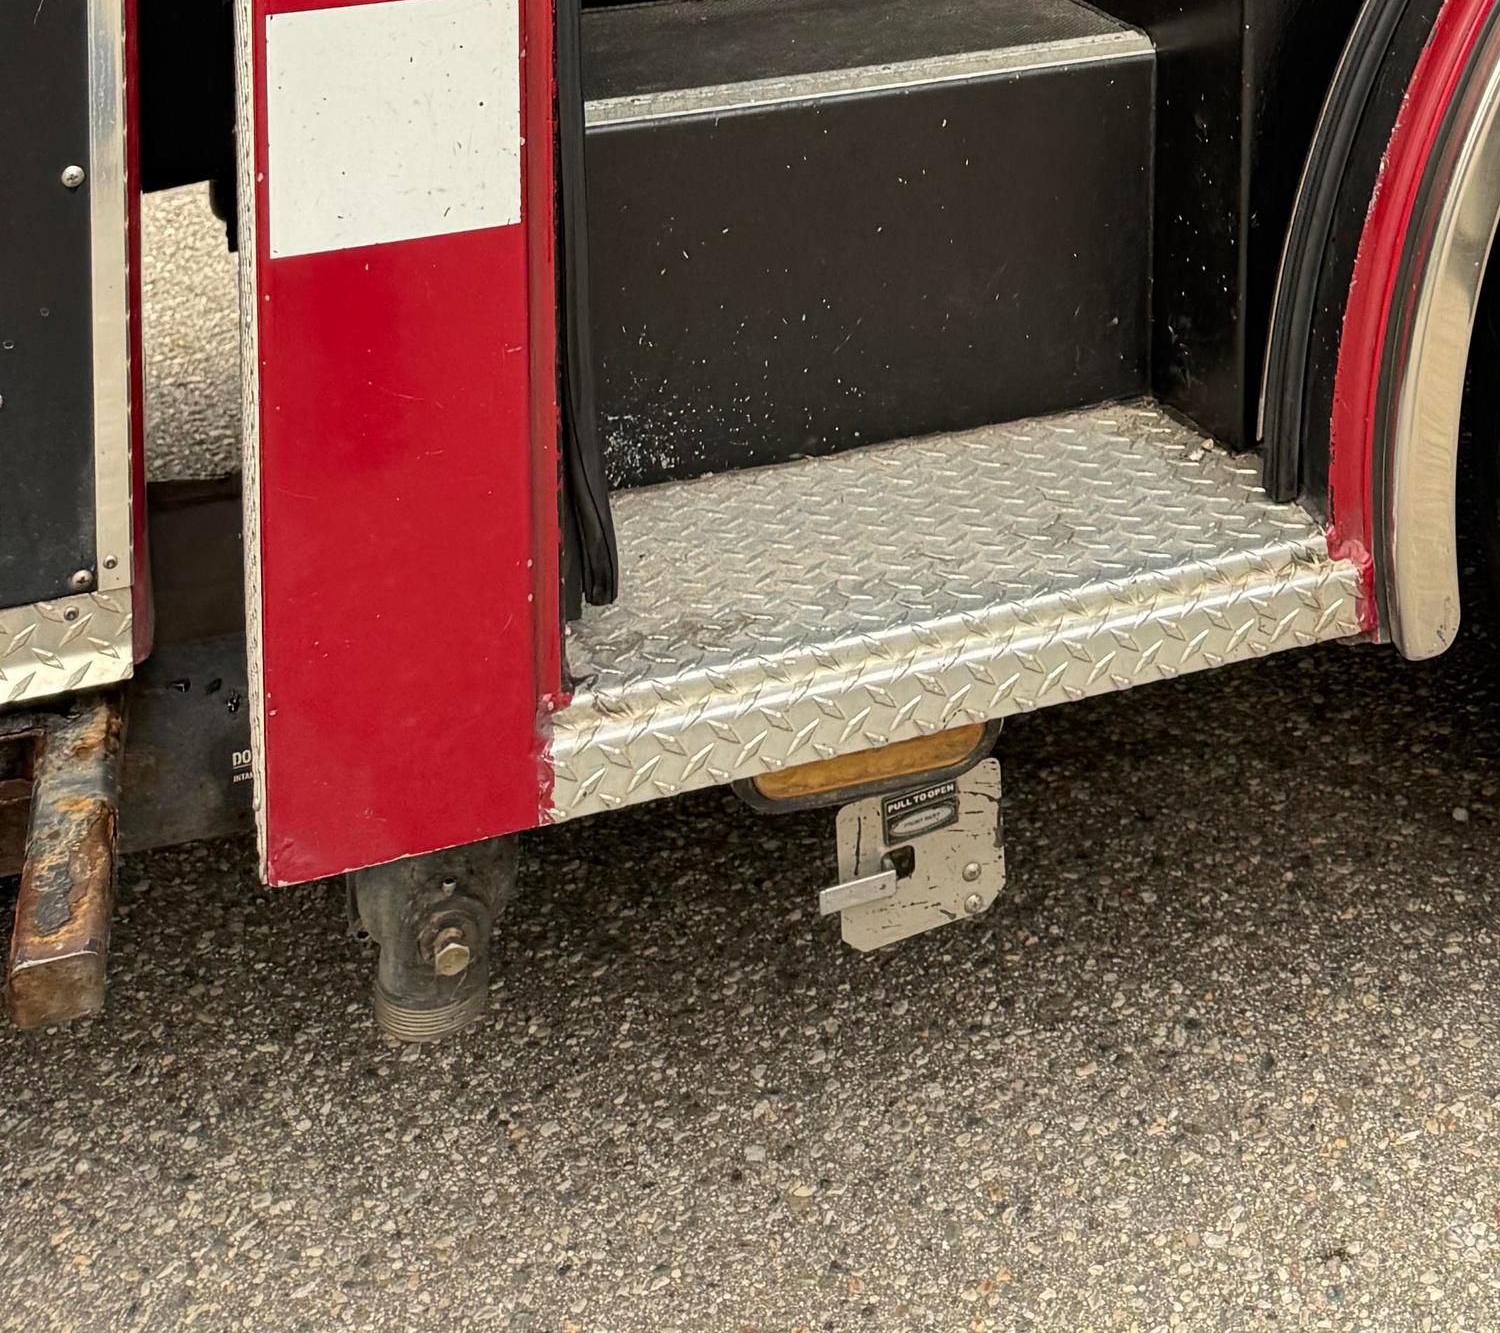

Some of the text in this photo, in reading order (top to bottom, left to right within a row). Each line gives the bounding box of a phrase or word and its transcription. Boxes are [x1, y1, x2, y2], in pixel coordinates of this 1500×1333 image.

[887, 783, 954, 813] PULL TO OPEN
